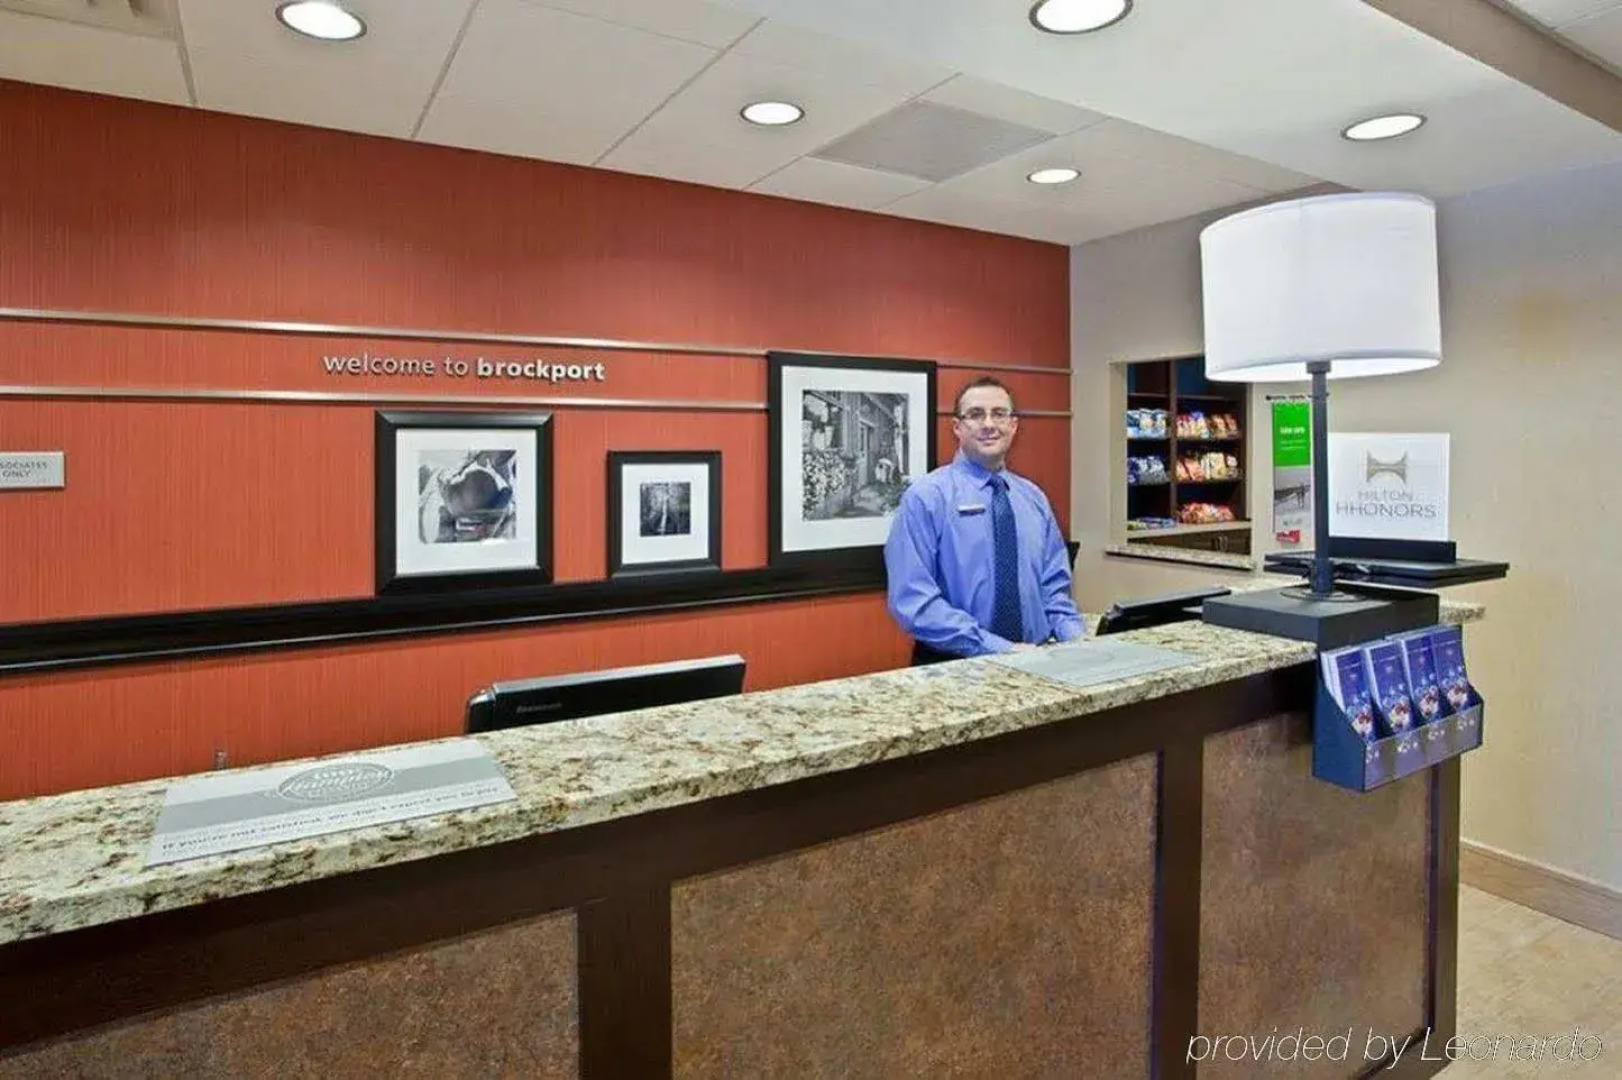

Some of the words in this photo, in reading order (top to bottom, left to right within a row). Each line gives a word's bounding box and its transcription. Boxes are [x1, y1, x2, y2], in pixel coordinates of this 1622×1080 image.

[323, 354, 436, 376] welcome
[444, 357, 470, 377] to
[477, 358, 606, 382] brockport
[1358, 489, 1413, 501] HILTON
[1335, 502, 1437, 518] HHONORS
